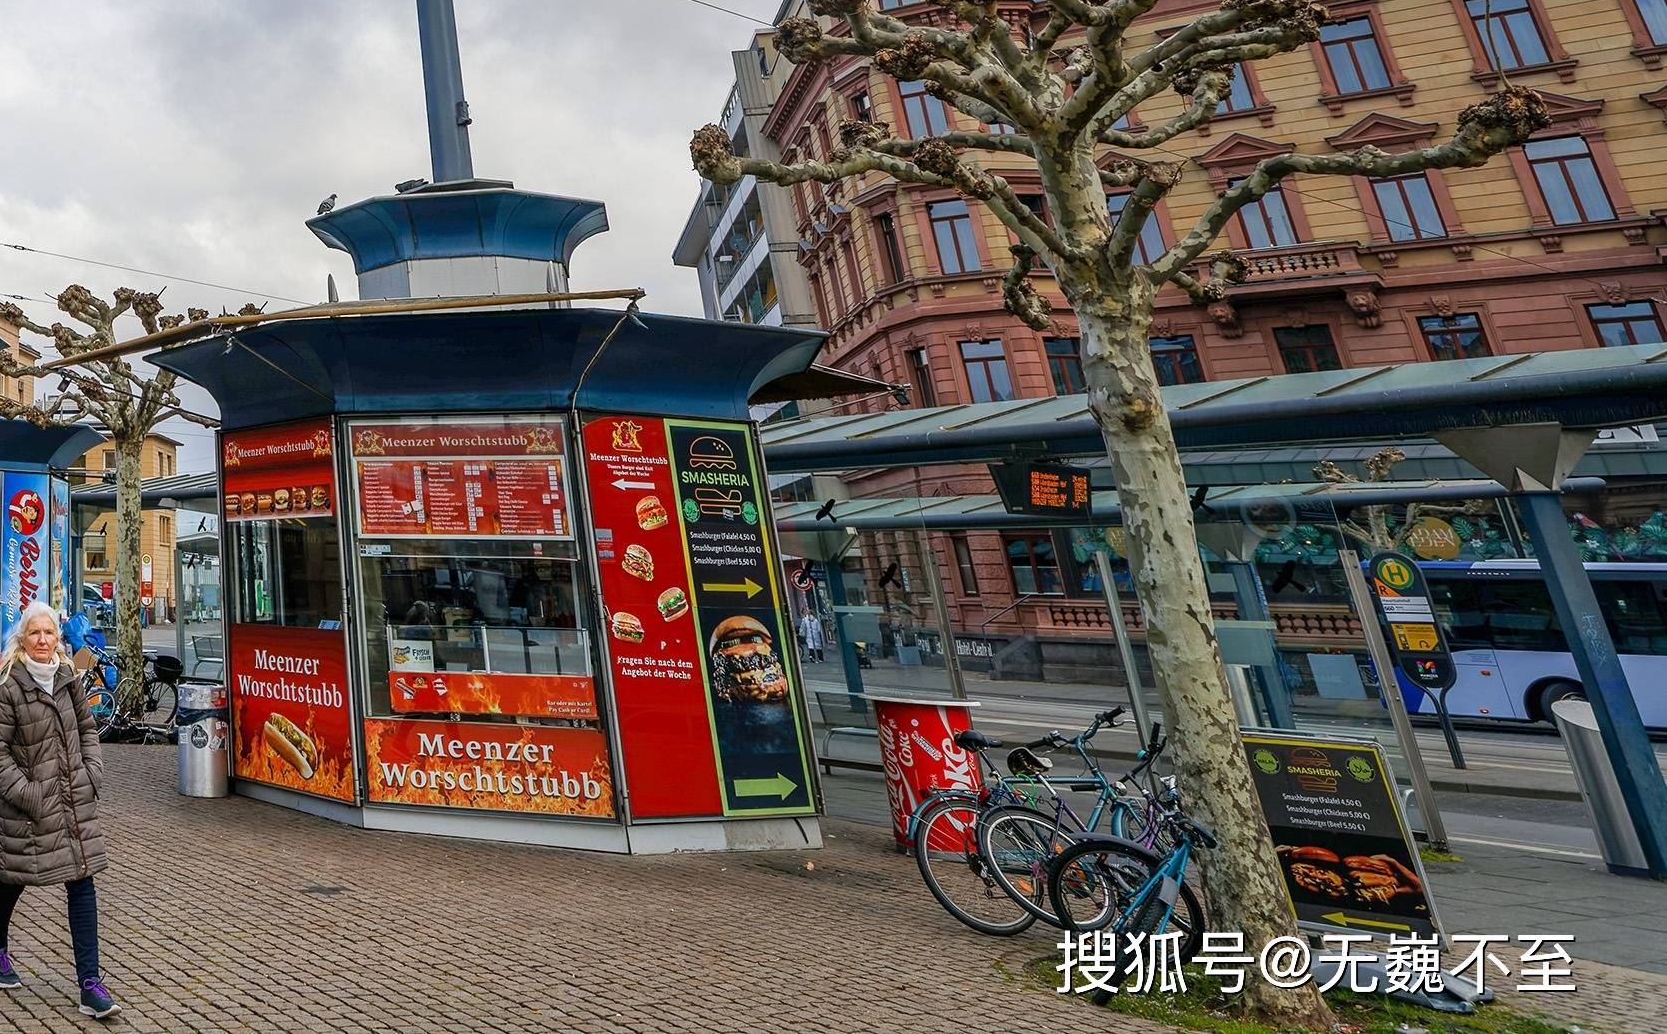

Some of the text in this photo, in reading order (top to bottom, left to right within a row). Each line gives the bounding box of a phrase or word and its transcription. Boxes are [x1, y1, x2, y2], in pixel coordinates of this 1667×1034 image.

[382, 435, 528, 447] Meenzer Worschtstubb
[238, 439, 315, 458] Meenzer Worschtstubb
[590, 453, 668, 465] Meenzer Worschtstubb
[681, 471, 750, 487] SMASHERIA
[690, 531, 720, 541] Smashburger
[692, 544, 723, 554] Smashburger
[694, 557, 725, 566] Smashburger
[1386, 565, 1405, 583] H
[1379, 585, 1389, 595] R
[253, 649, 319, 676] Meenzer
[644, 656, 656, 666] Sie
[658, 657, 675, 667] nach
[677, 658, 694, 668] dem
[621, 667, 692, 680] Angebot der Woche
[237, 674, 343, 709] Worschtstubb
[417, 732, 555, 764] Meenzer
[1287, 765, 1342, 778] SMASHERIA
[379, 762, 603, 801] Worschtstubb
[1282, 792, 1319, 804] Smashburger
[1286, 805, 1323, 816] Smashburger
[1290, 816, 1327, 827] Smashburger
